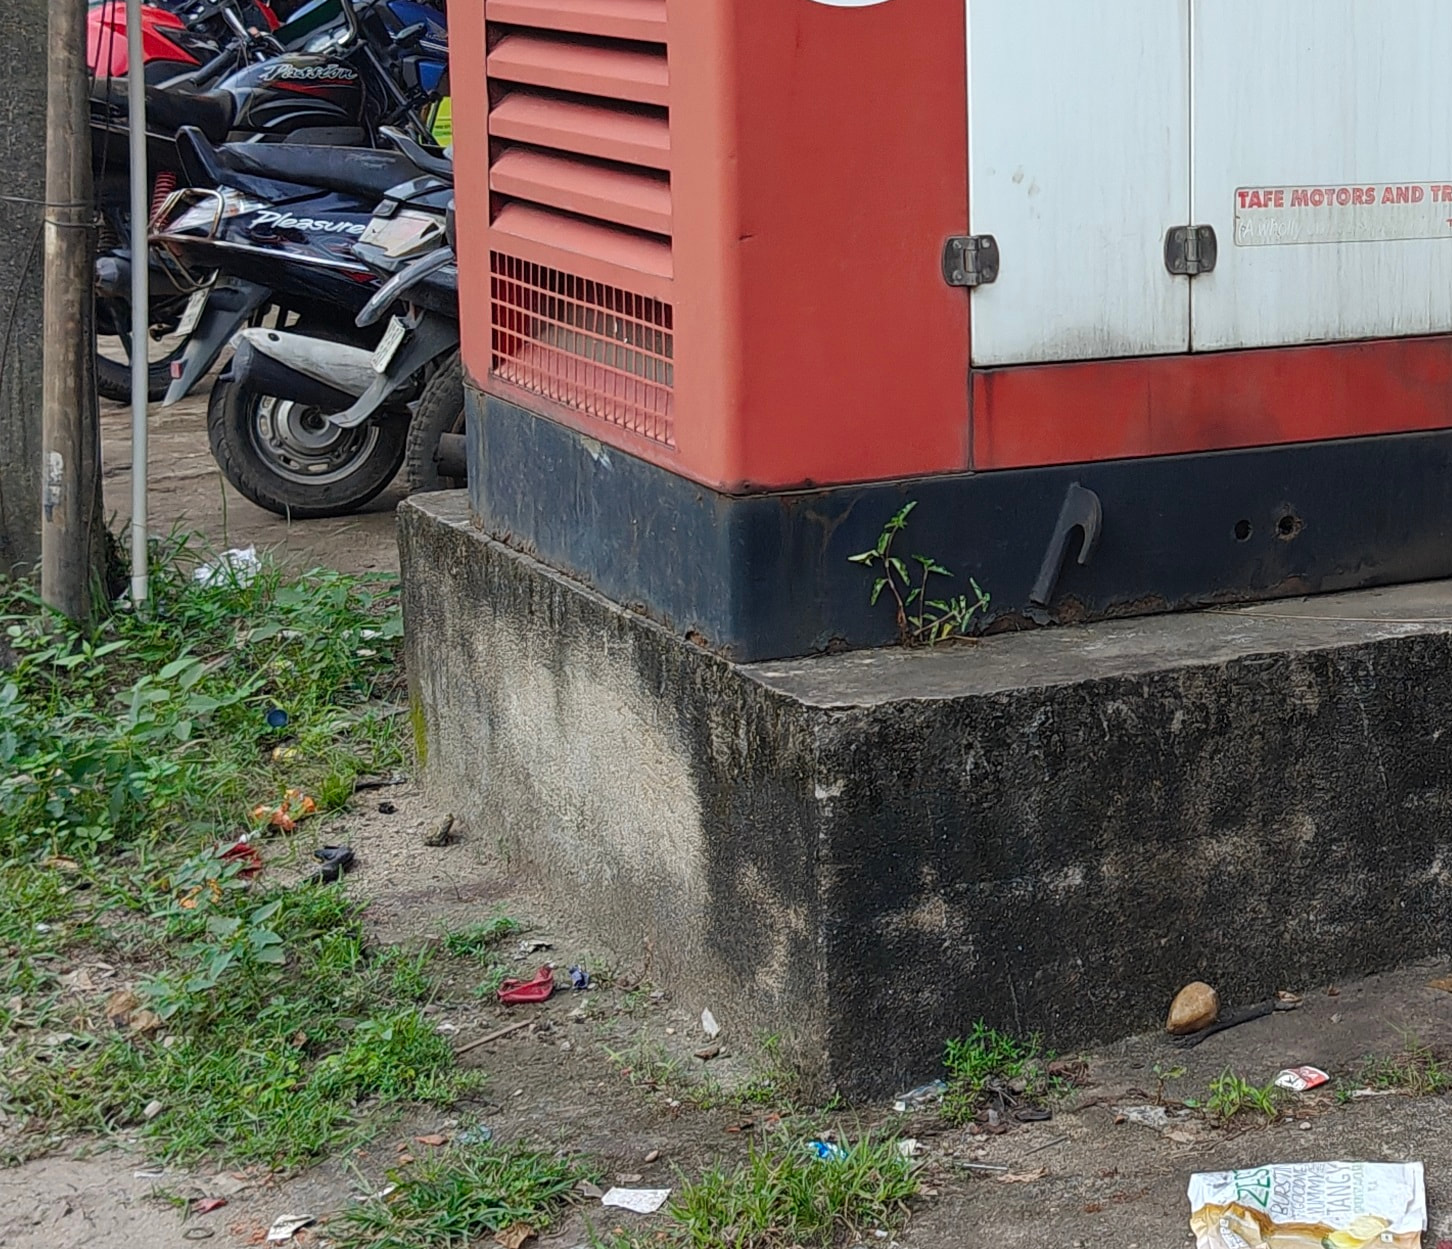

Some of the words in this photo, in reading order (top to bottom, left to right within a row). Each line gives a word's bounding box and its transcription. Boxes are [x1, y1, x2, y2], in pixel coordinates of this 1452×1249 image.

[258, 63, 359, 81] Passion
[1238, 189, 1285, 209] TAFE
[1290, 187, 1376, 208] MOTORS
[1381, 186, 1424, 205] AND
[249, 210, 367, 235] Pleasure
